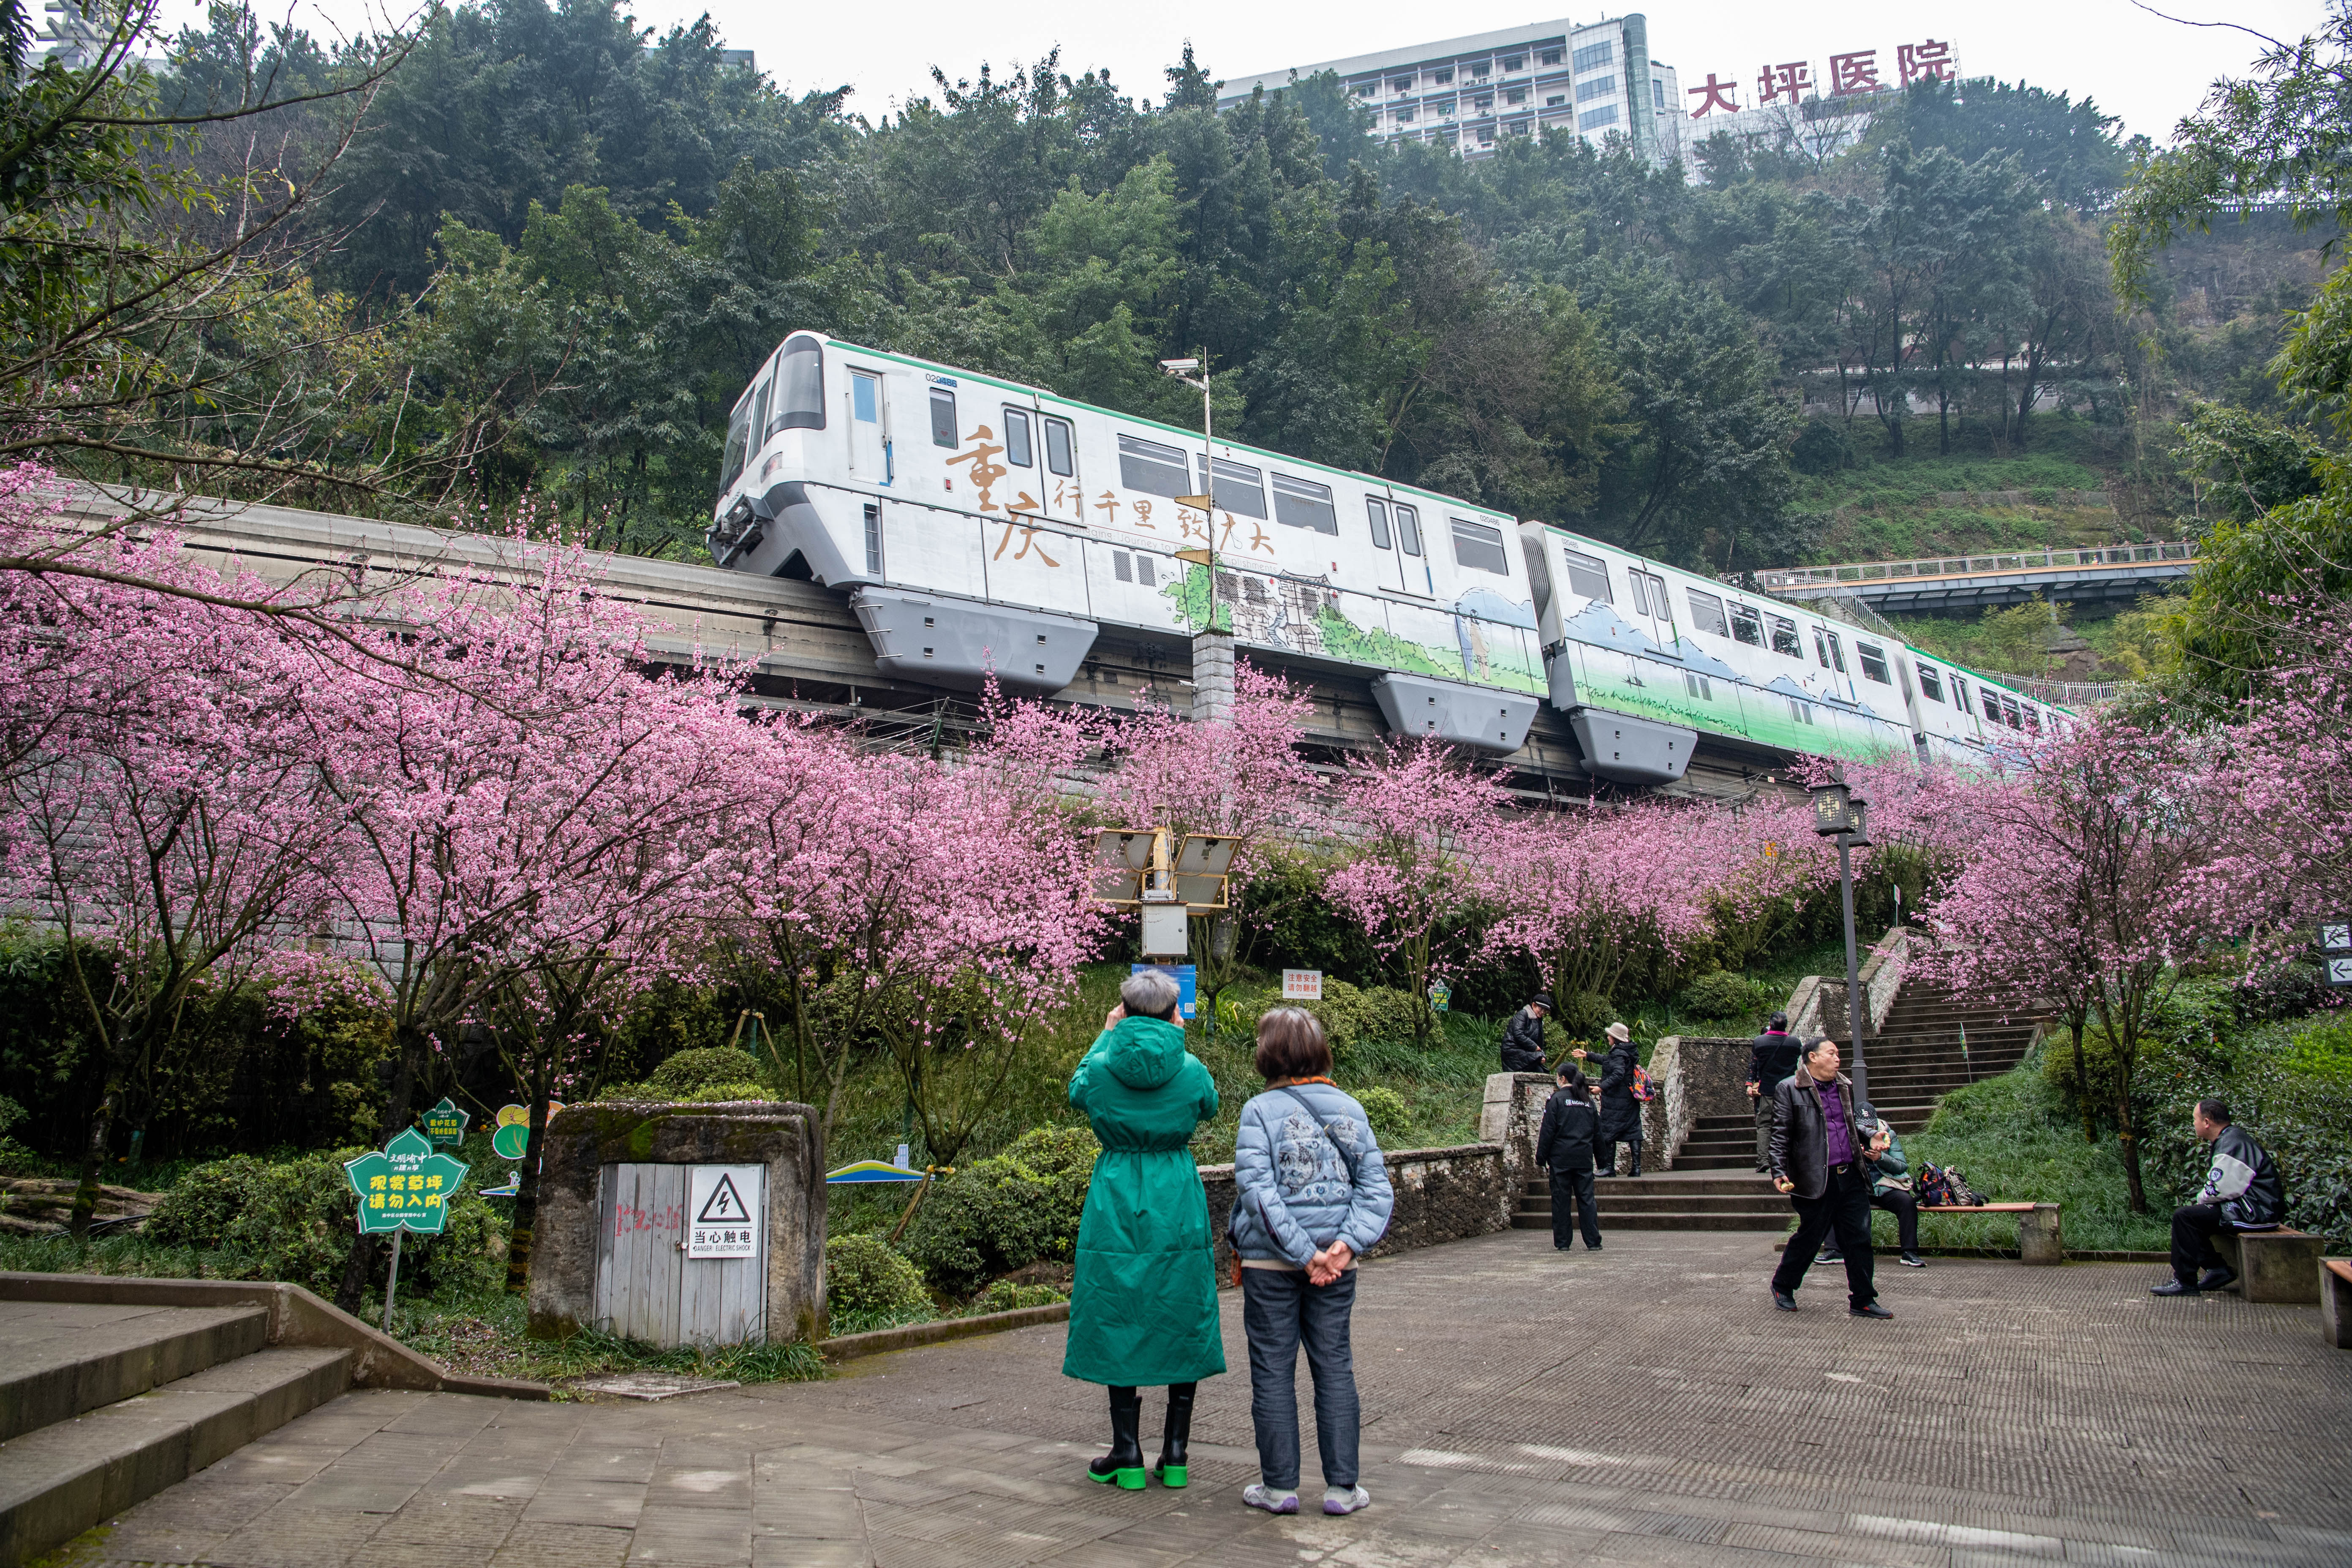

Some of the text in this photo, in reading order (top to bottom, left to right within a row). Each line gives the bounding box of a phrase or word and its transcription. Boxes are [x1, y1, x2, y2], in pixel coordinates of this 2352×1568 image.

[1688, 38, 1955, 119] 大坪医院
[926, 373, 957, 388] 020486
[946, 425, 1060, 567] 重庆
[1480, 515, 1500, 525] 020486
[1120, 533, 1157, 550] Journey
[1161, 542, 1171, 552] to
[1561, 538, 1579, 548] 020485
[1288, 973, 1318, 983] 注意安全
[1288, 983, 1318, 992] 请勿翻越
[389, 1152, 427, 1164] 文明渝中
[370, 1175, 443, 1191] 观赏草坪
[369, 1193, 441, 1209] 请勿入内
[695, 1230, 751, 1244] 当心触电
